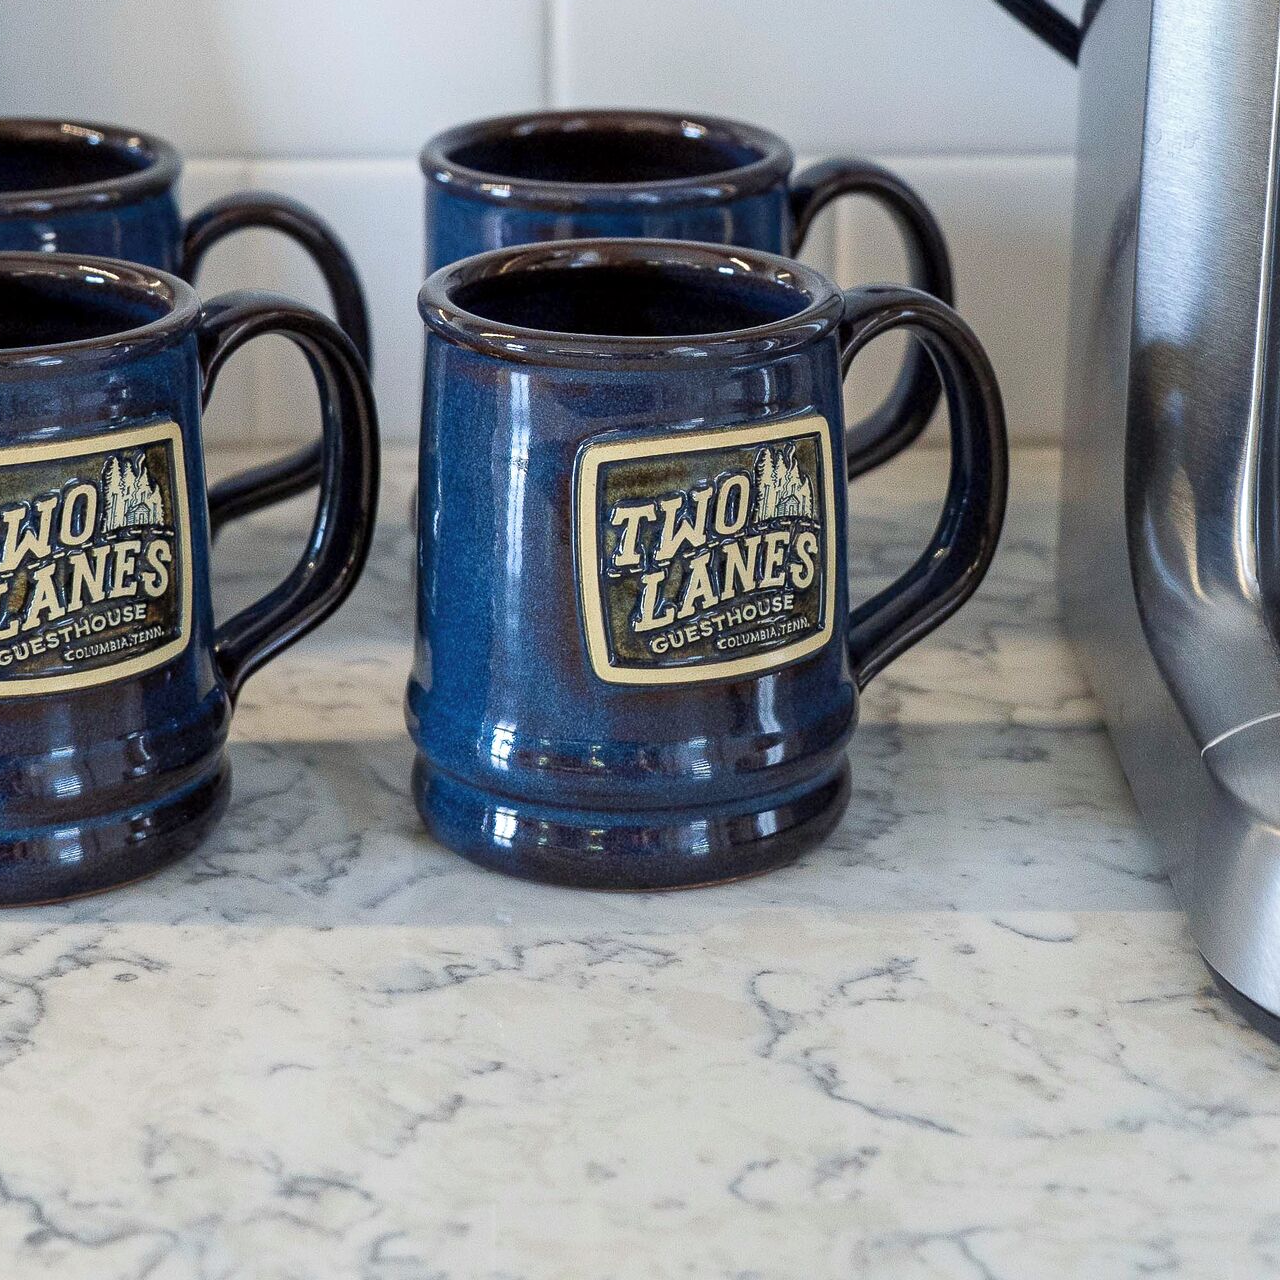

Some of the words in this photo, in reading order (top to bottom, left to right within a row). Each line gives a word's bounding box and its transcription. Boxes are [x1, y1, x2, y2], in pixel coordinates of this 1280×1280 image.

[610, 473, 752, 567] TWO
[633, 530, 818, 633] LANES
[131, 625, 165, 645] TENN.
[650, 593, 795, 655] GUESTHOUSE
[780, 616, 811, 635] TENN.
